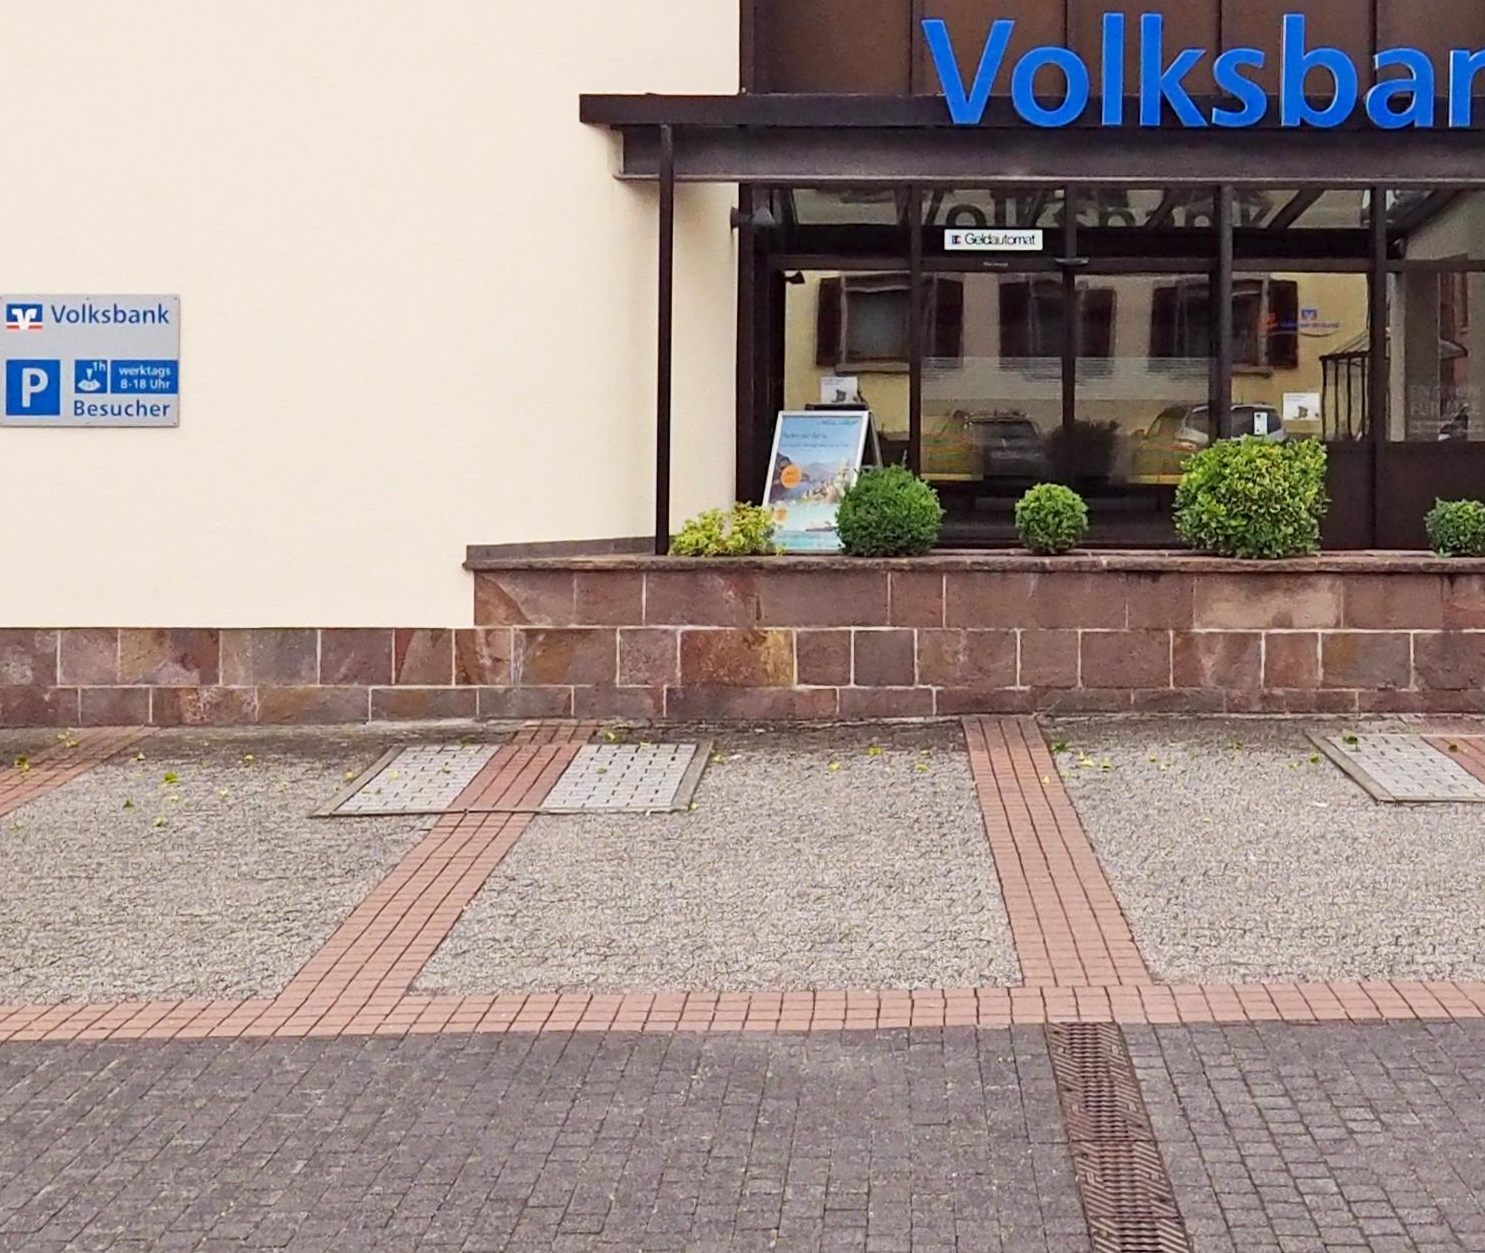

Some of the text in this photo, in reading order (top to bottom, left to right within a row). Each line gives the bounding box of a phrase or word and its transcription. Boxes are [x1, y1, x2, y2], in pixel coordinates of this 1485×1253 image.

[964, 233, 1035, 245] Geldautomat
[51, 303, 170, 324] Volksbank
[93, 361, 106, 372] 1h
[118, 365, 171, 378] werktags
[21, 367, 49, 408] P
[120, 378, 171, 389] 8-18 Uhr
[74, 399, 171, 417] Besucher
